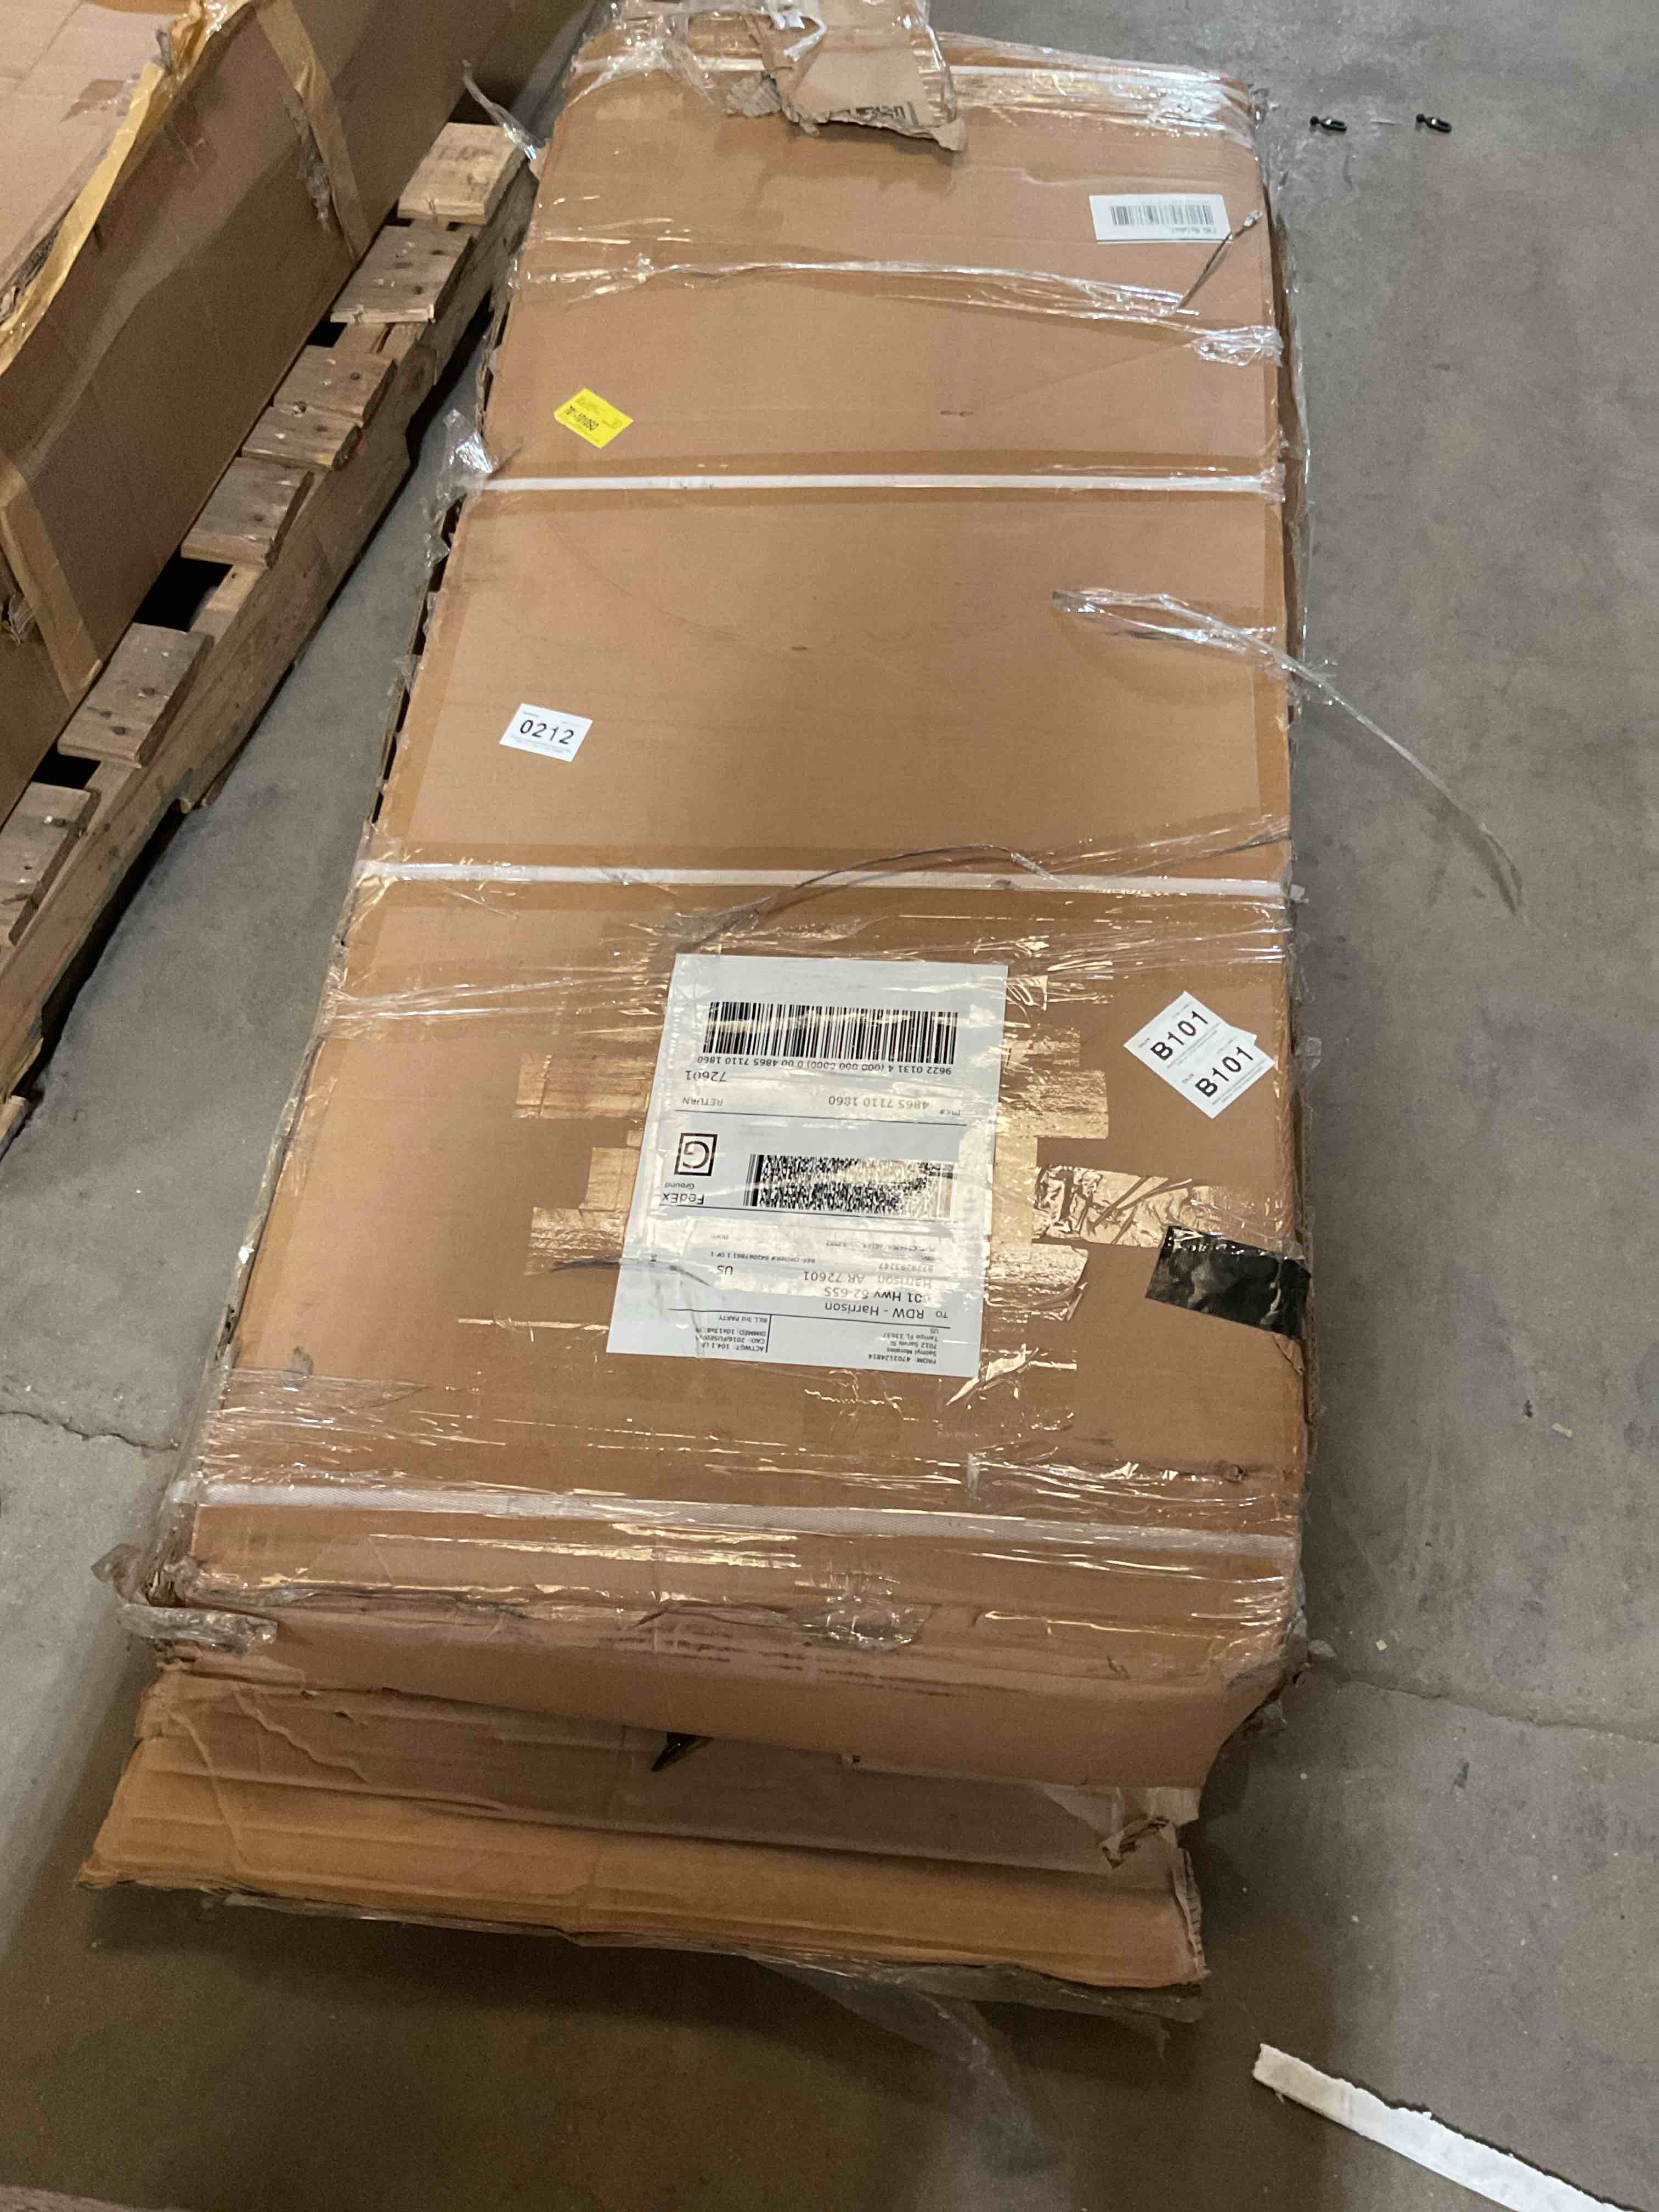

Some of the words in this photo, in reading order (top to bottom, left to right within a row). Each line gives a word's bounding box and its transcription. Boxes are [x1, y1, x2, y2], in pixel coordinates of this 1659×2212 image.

[520, 720, 574, 744] 0212
[1150, 1011, 1208, 1060] B101
[697, 1056, 721, 1064] 1860
[725, 1057, 749, 1065] 7110
[753, 1058, 778, 1066] 4865
[861, 1063, 884, 1071] (000
[898, 1065, 923, 1074] 0131
[927, 1066, 952, 1075] 9622
[1195, 1047, 1253, 1097] B101
[685, 1070, 727, 1082] 72601
[682, 1097, 723, 1107] RETURN
[828, 1096, 859, 1106] 1860
[863, 1097, 893, 1108] 7110
[898, 1099, 929, 1109] 4865
[682, 1141, 710, 1169] G
[662, 1193, 704, 1205] FedEx
[716, 1265, 733, 1276] US
[803, 1271, 842, 1283] 72601
[847, 1273, 865, 1283] AR
[878, 1275, 932, 1289] Harrison
[825, 1302, 879, 1316] Harrison
[892, 1308, 924, 1319] RDW
[935, 1311, 948, 1319] TO
